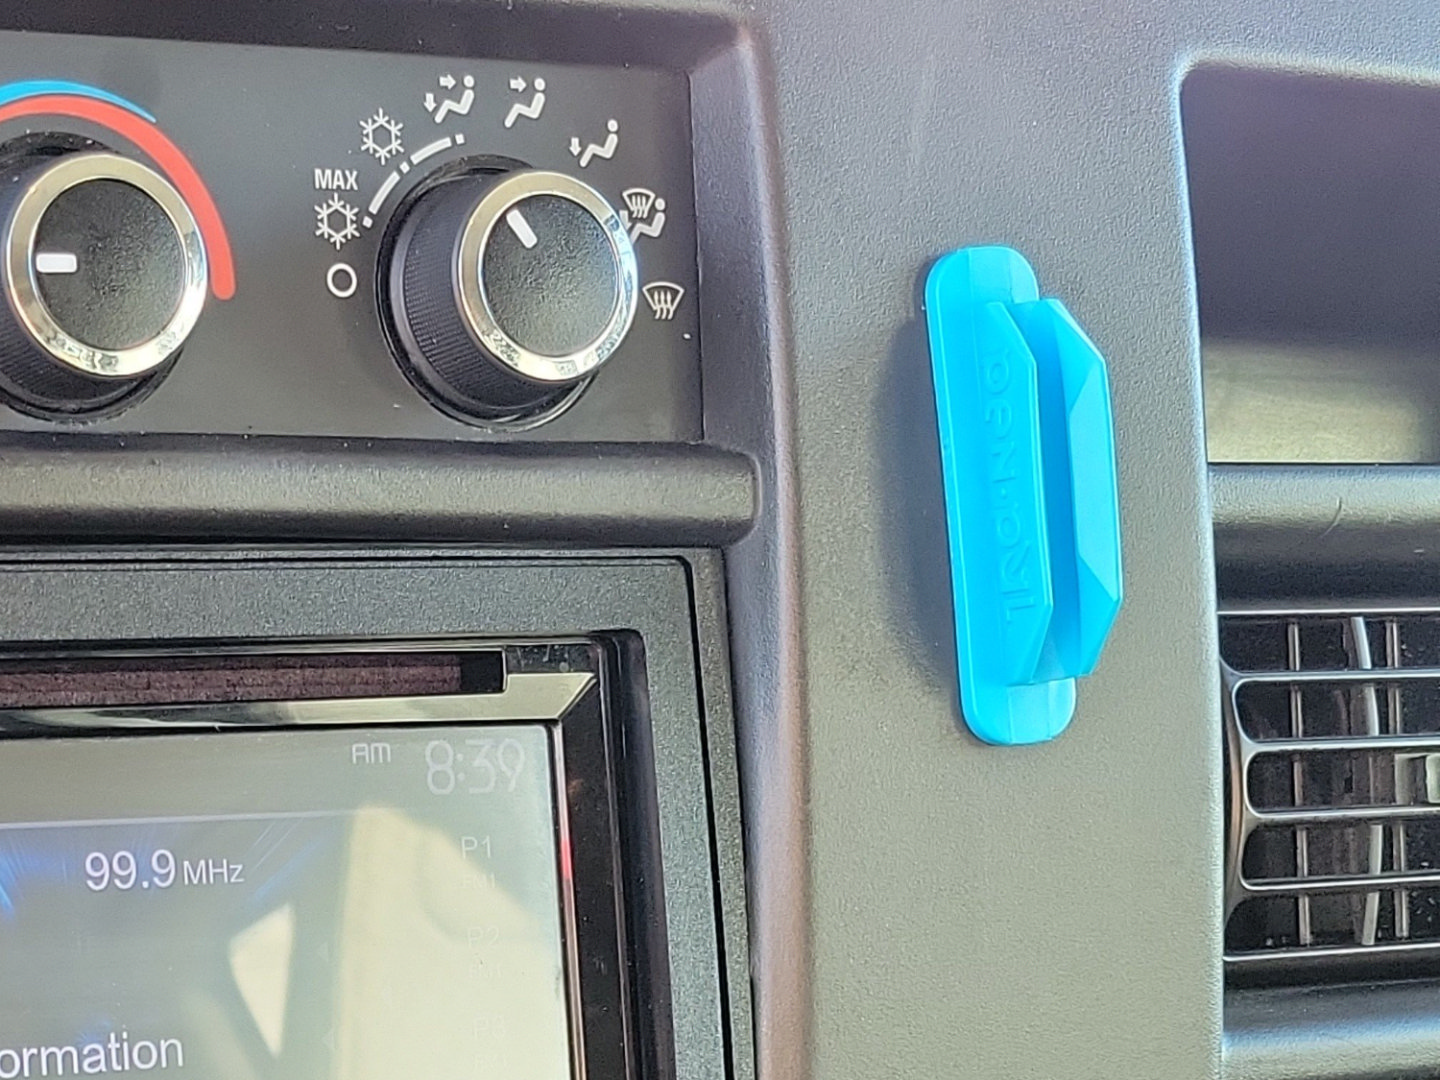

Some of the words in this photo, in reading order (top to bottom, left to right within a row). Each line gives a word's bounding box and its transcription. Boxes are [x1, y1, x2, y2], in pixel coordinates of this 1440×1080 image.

[314, 168, 358, 191] MAX
[352, 742, 391, 764] AM
[424, 738, 525, 796] 8:39
[461, 834, 492, 860] P1
[84, 849, 177, 892] 99.9
[182, 859, 246, 887] MHz
